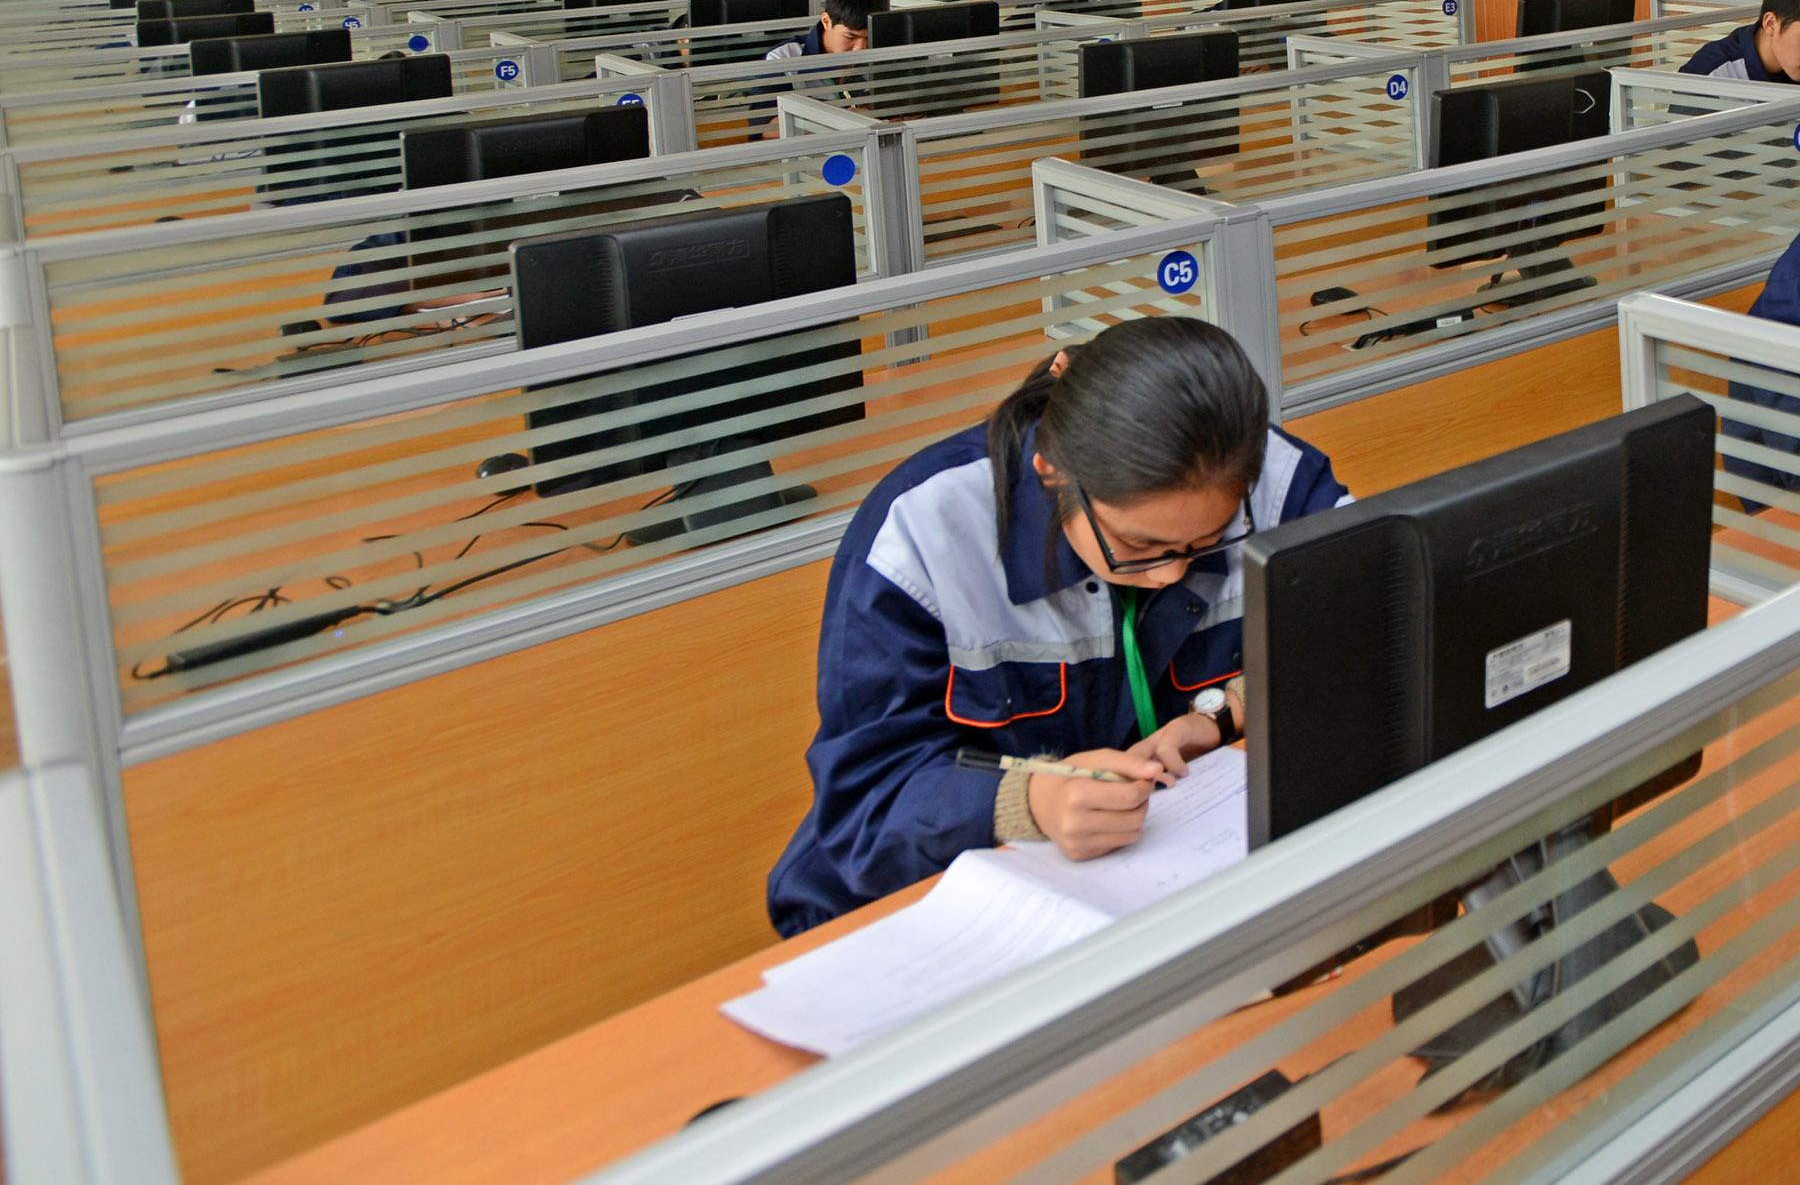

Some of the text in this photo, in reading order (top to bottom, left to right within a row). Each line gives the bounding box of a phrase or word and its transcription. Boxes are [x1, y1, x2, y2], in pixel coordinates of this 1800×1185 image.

[1445, 2, 1455, 13] E3
[500, 65, 516, 77] F5
[1390, 80, 1406, 95] D4
[1164, 260, 1192, 286] C5
